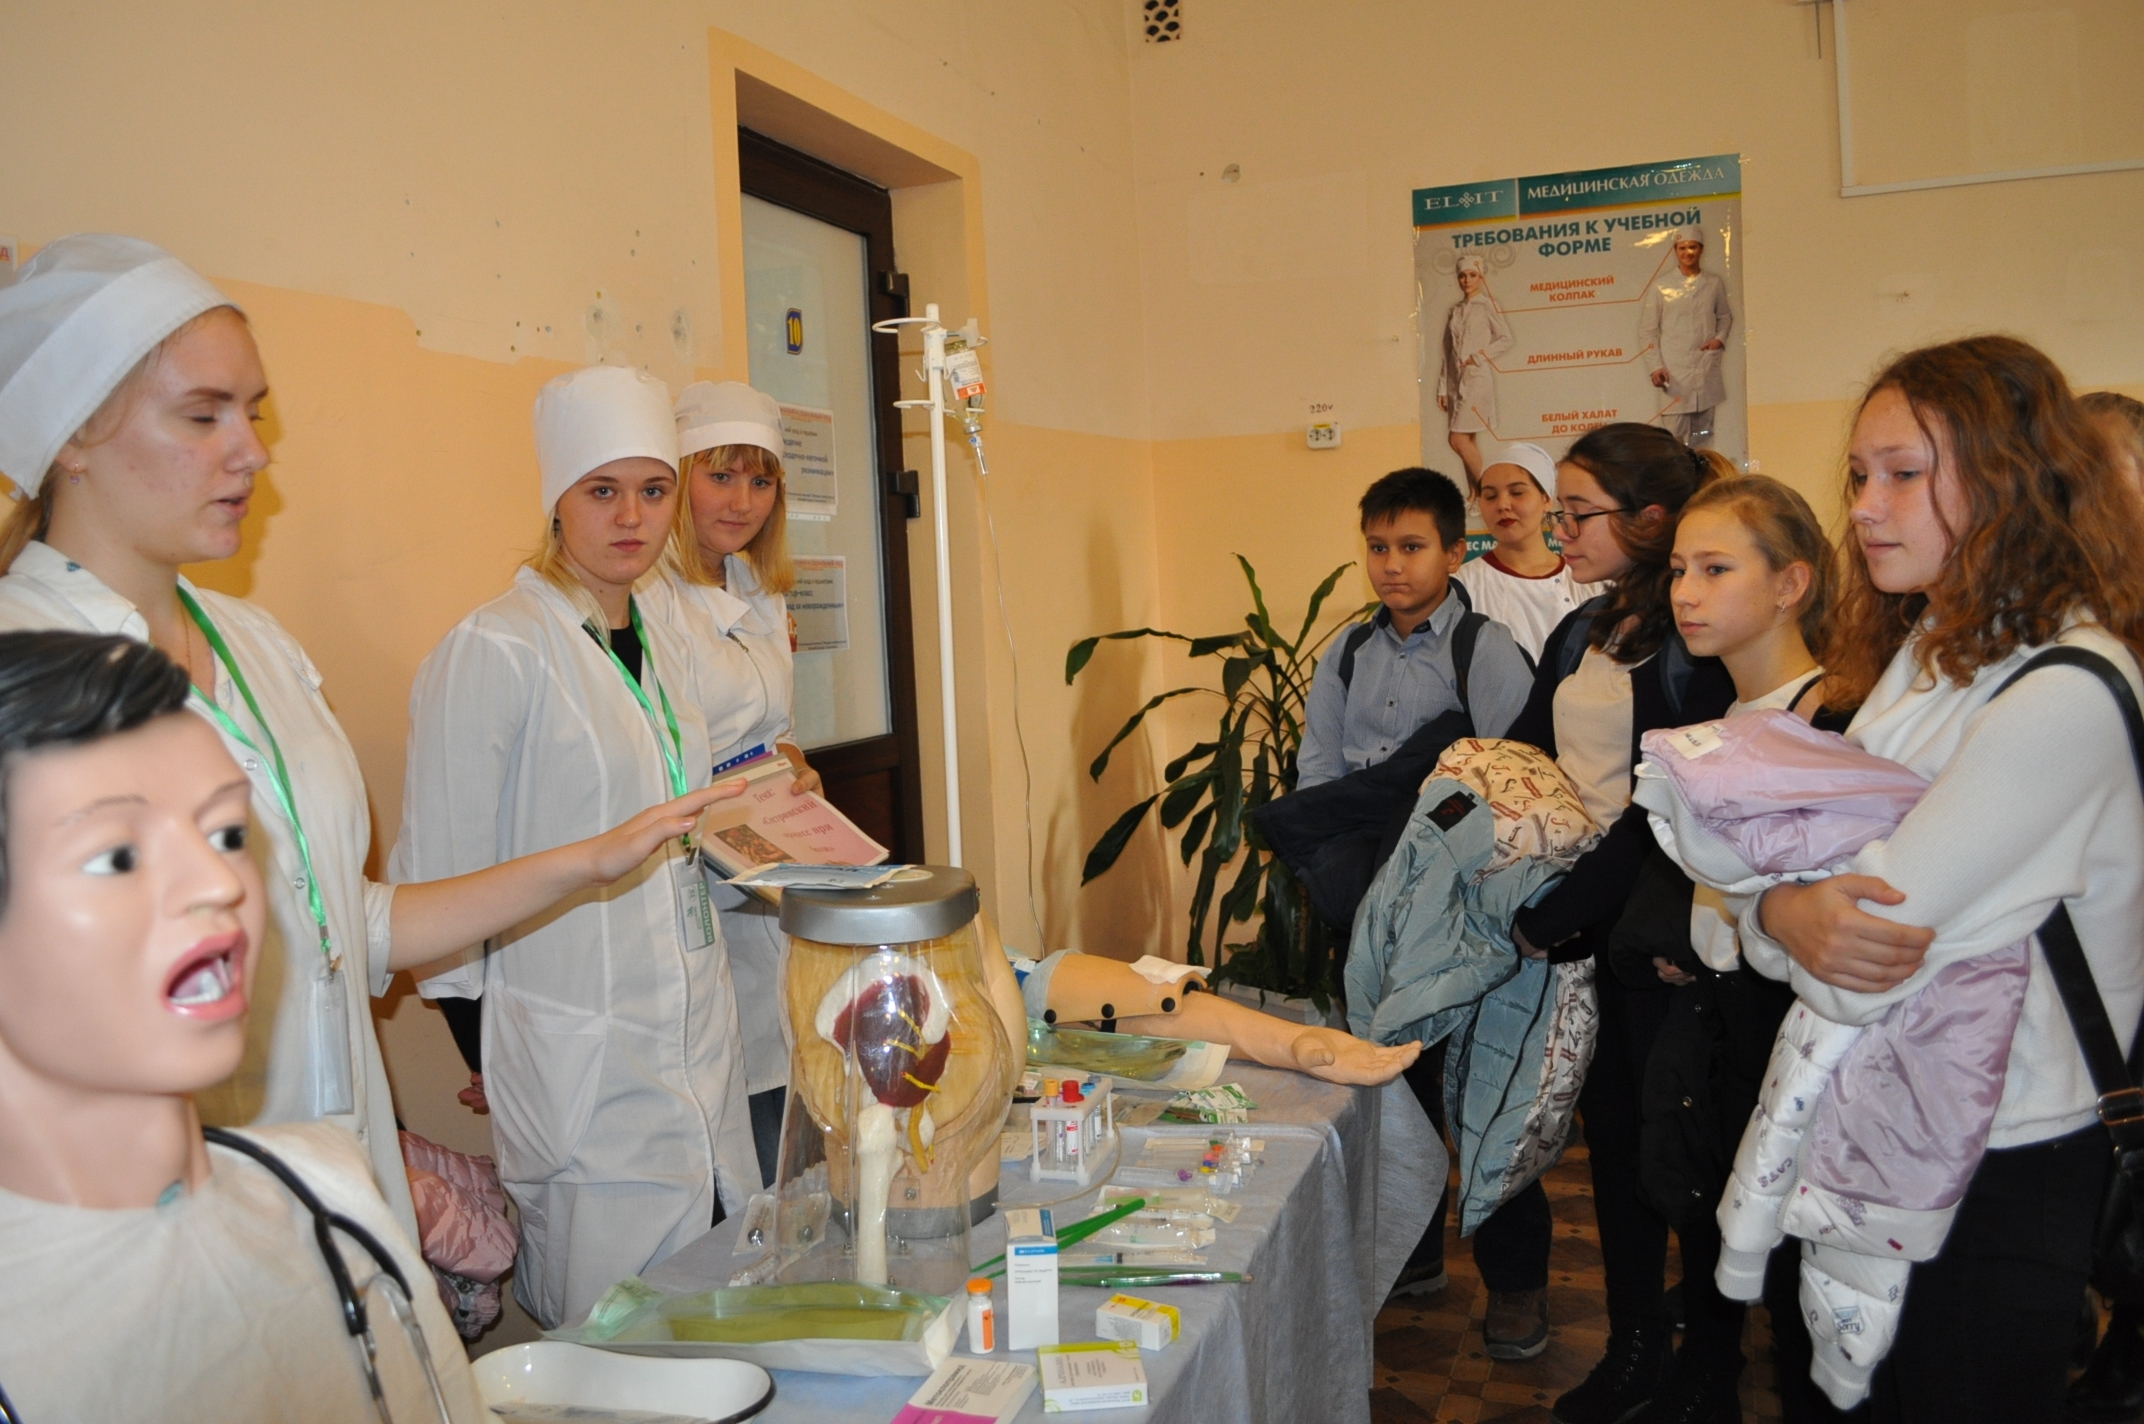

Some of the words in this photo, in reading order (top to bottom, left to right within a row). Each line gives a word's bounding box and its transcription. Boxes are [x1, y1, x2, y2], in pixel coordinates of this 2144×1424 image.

[1527, 174, 1649, 199] МЕДИЦИНСКАЯ
[1653, 167, 1725, 186] ОДЕЖДА
[1452, 222, 1580, 249] ТРЕБОВАНИЯ
[1586, 220, 1599, 235] К
[1603, 207, 1701, 233] УЧЕБНОЙ
[1538, 237, 1611, 258] ФОРМЕ
[1530, 275, 1614, 292] МЕДИЦИНСКИЙ
[1549, 290, 1595, 302] КОЛПАК
[1527, 349, 1584, 365] ДЛИННЫЙ
[1587, 348, 1622, 359] РУКАВ
[1541, 410, 1579, 422] БЕЛЫЙ
[1581, 409, 1617, 420] ХАЛАТ
[1551, 424, 1568, 434] ДО
[1570, 422, 1607, 432] КОЛЕ
[1466, 541, 1479, 551] ЕС
[1481, 540, 1498, 551] МА
